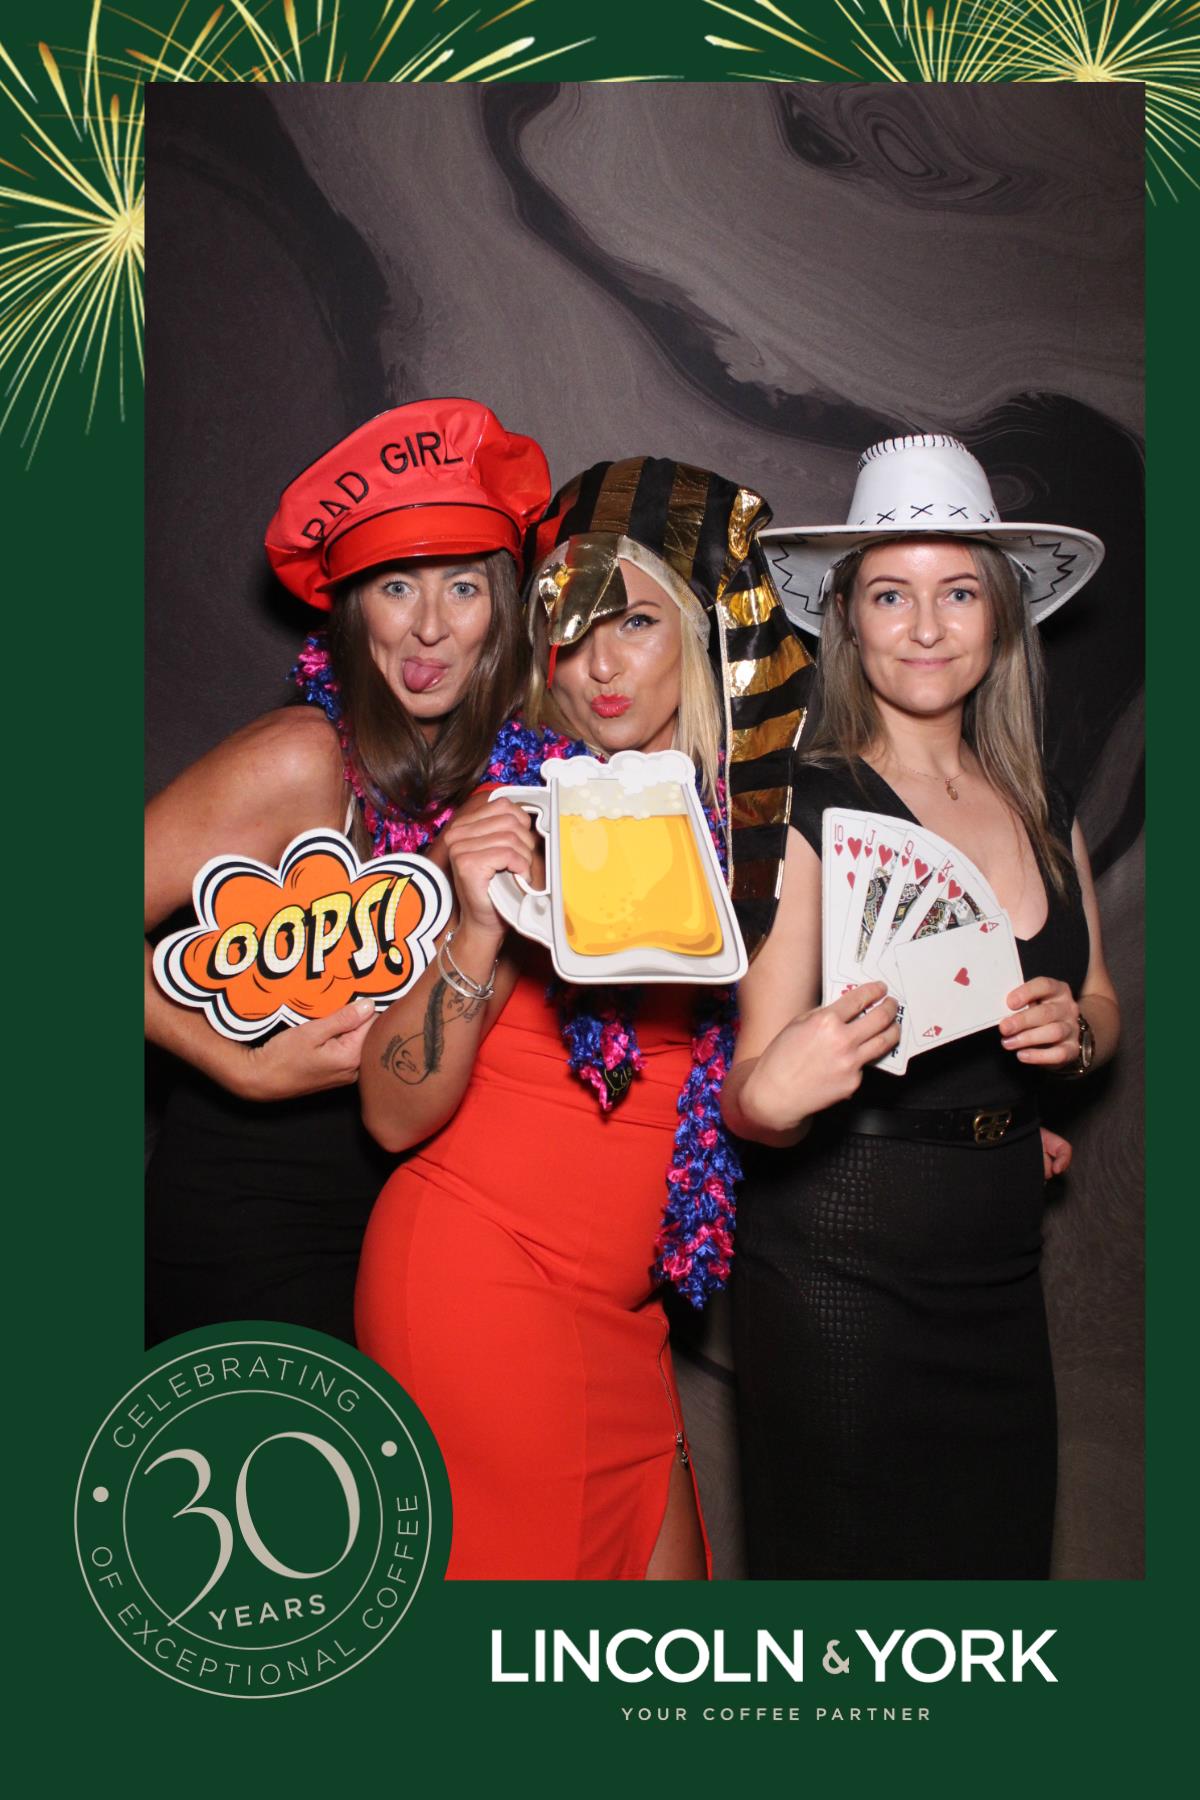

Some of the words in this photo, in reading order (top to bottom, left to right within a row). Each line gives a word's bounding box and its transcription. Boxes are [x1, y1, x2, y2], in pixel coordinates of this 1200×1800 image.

[380, 431, 464, 474] GIRL
[834, 824, 844, 842] 10
[866, 830, 876, 845] J
[902, 840, 915, 859] Q
[941, 860, 954, 873] K
[206, 873, 414, 980] OOPS!
[987, 921, 1000, 931] A
[922, 1026, 934, 1038] A
